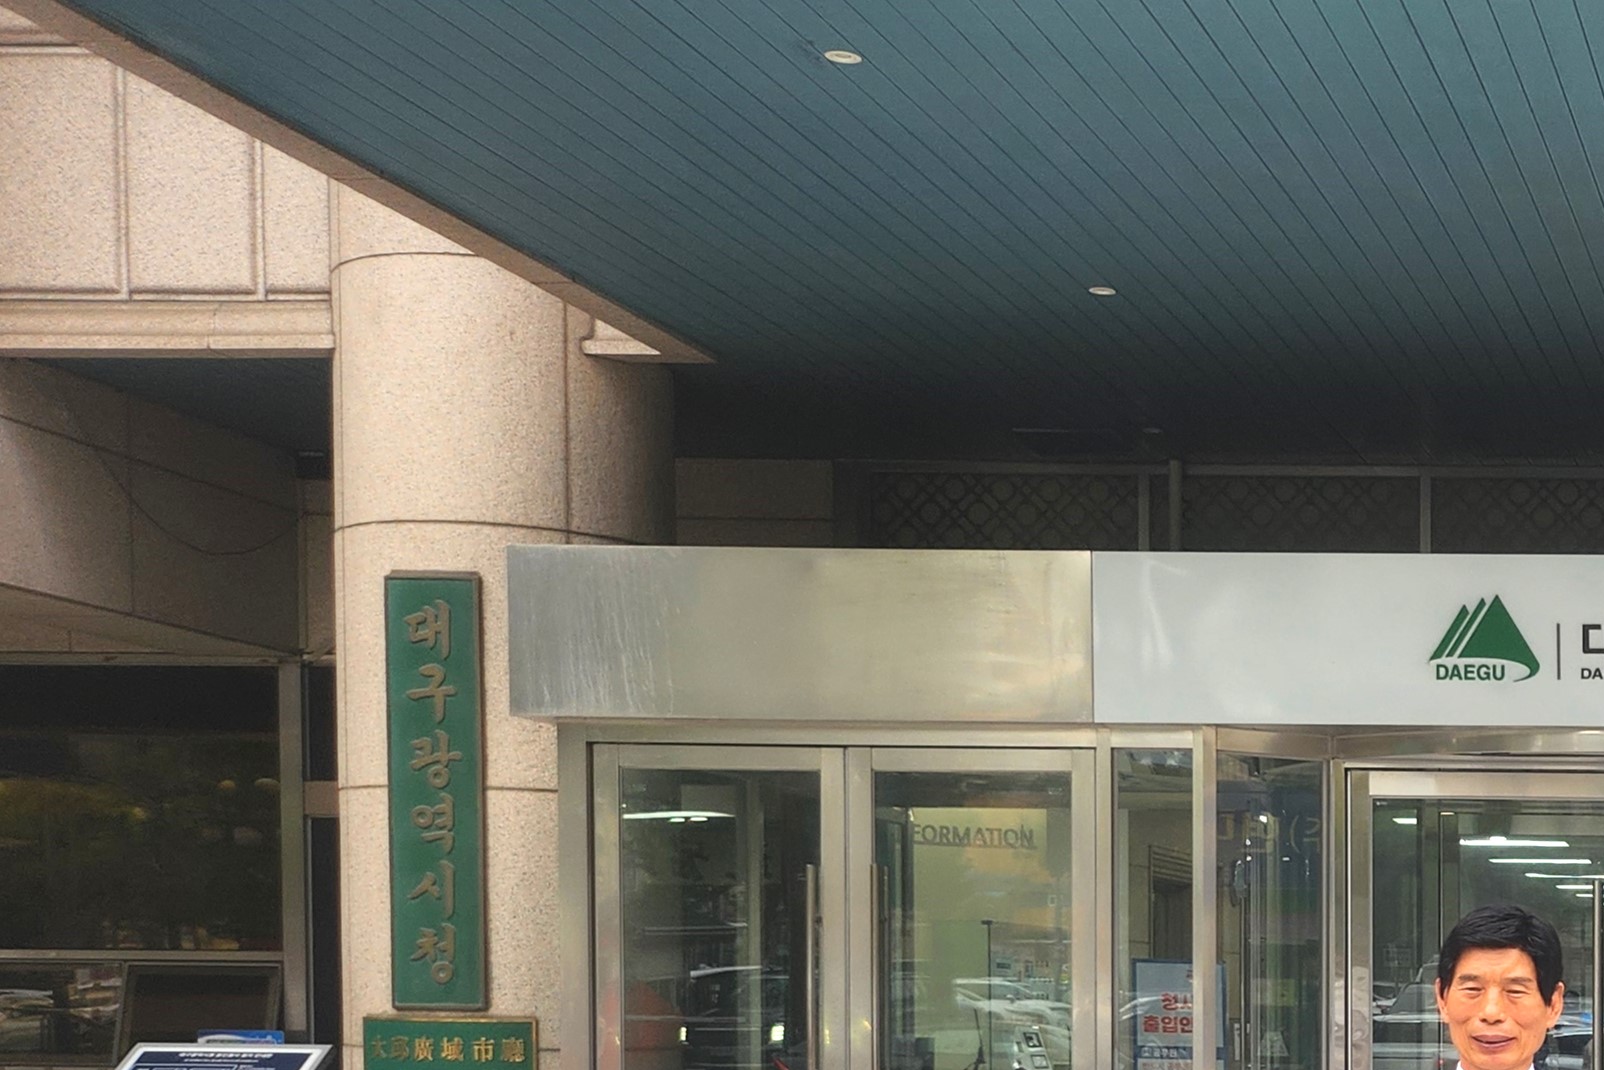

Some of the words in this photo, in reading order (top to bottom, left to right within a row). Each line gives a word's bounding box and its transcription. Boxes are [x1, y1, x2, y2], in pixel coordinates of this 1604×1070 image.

[1435, 663, 1505, 682] DAEGU
[404, 599, 462, 986] 대구광역시청
[912, 824, 1034, 849] FORMATION
[1143, 1015, 1193, 1034] 출입안
